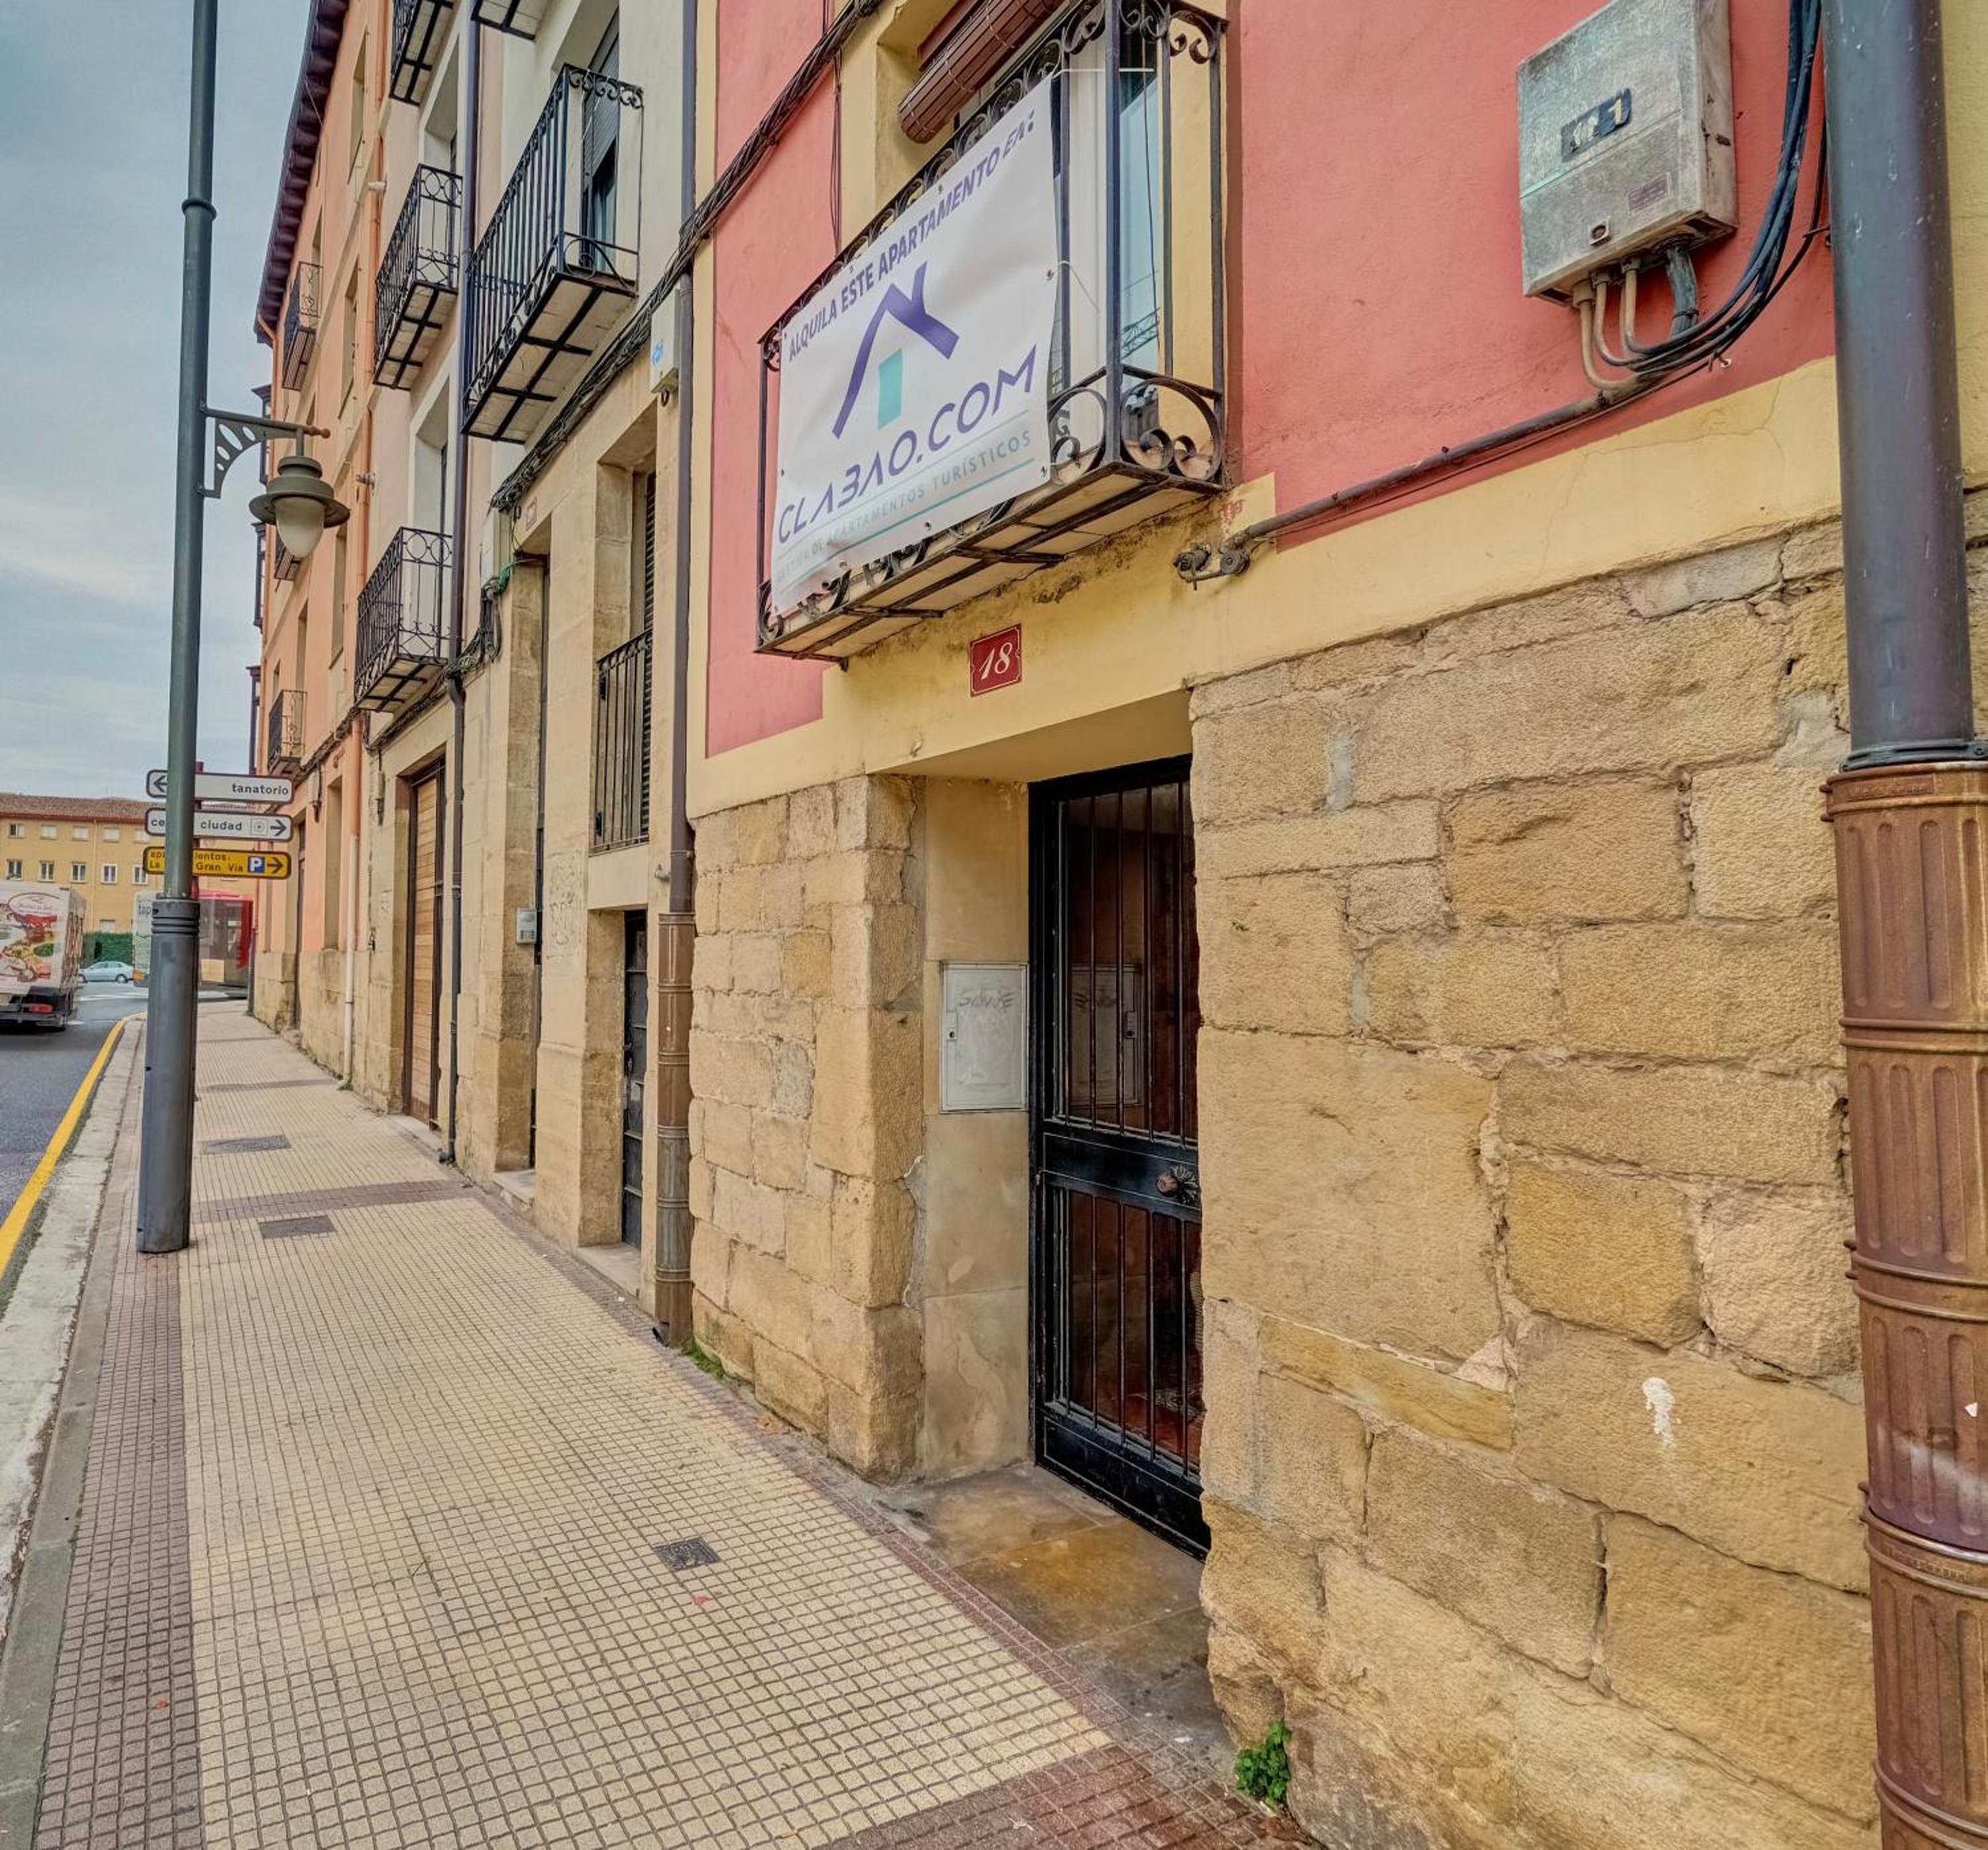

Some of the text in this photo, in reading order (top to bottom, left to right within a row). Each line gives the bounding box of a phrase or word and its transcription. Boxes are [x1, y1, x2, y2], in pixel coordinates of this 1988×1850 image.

[789, 298, 838, 362] ALQUILA
[840, 265, 875, 314] ESTE
[877, 146, 1001, 282] APARTAMENTO
[978, 641, 1013, 680] 18
[232, 783, 289, 795] tanatorio
[200, 820, 243, 831] ciudad
[195, 862, 221, 871] Gran
